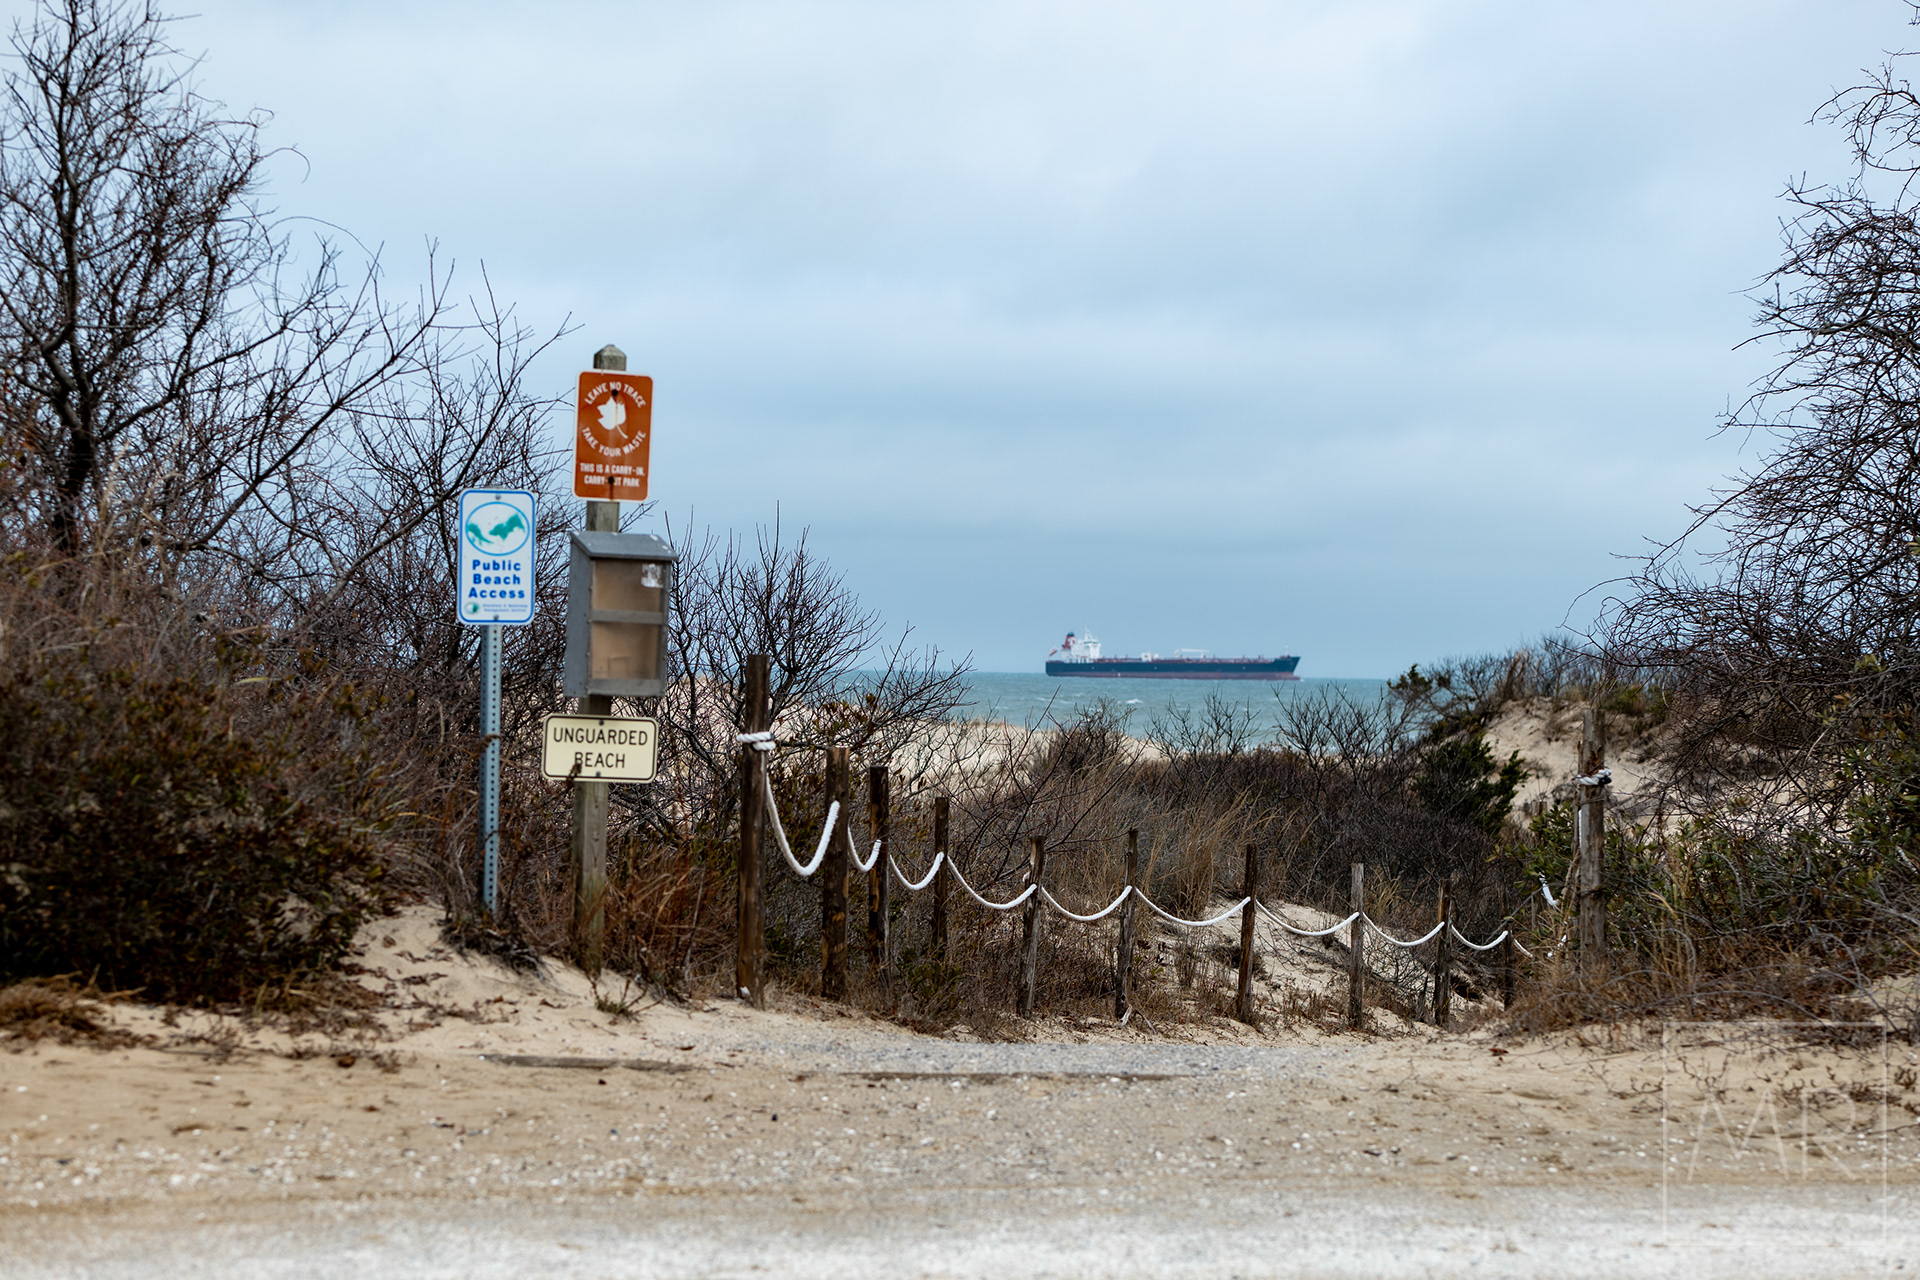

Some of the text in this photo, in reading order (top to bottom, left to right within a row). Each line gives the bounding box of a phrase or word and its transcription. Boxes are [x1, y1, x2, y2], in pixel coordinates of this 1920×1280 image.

[584, 381, 646, 408] LEAVE NO TRACE
[582, 426, 646, 457] TAKE YOUR WASTE
[580, 463, 595, 472] THIS
[596, 463, 604, 473] IS
[605, 464, 610, 473] A
[584, 475, 640, 486] CARRY-UT PARK
[472, 559, 521, 571] Public
[473, 573, 521, 585] Beach
[468, 587, 525, 599] Access
[553, 727, 648, 745] UNGUARDED
[574, 751, 626, 768] BEACH
